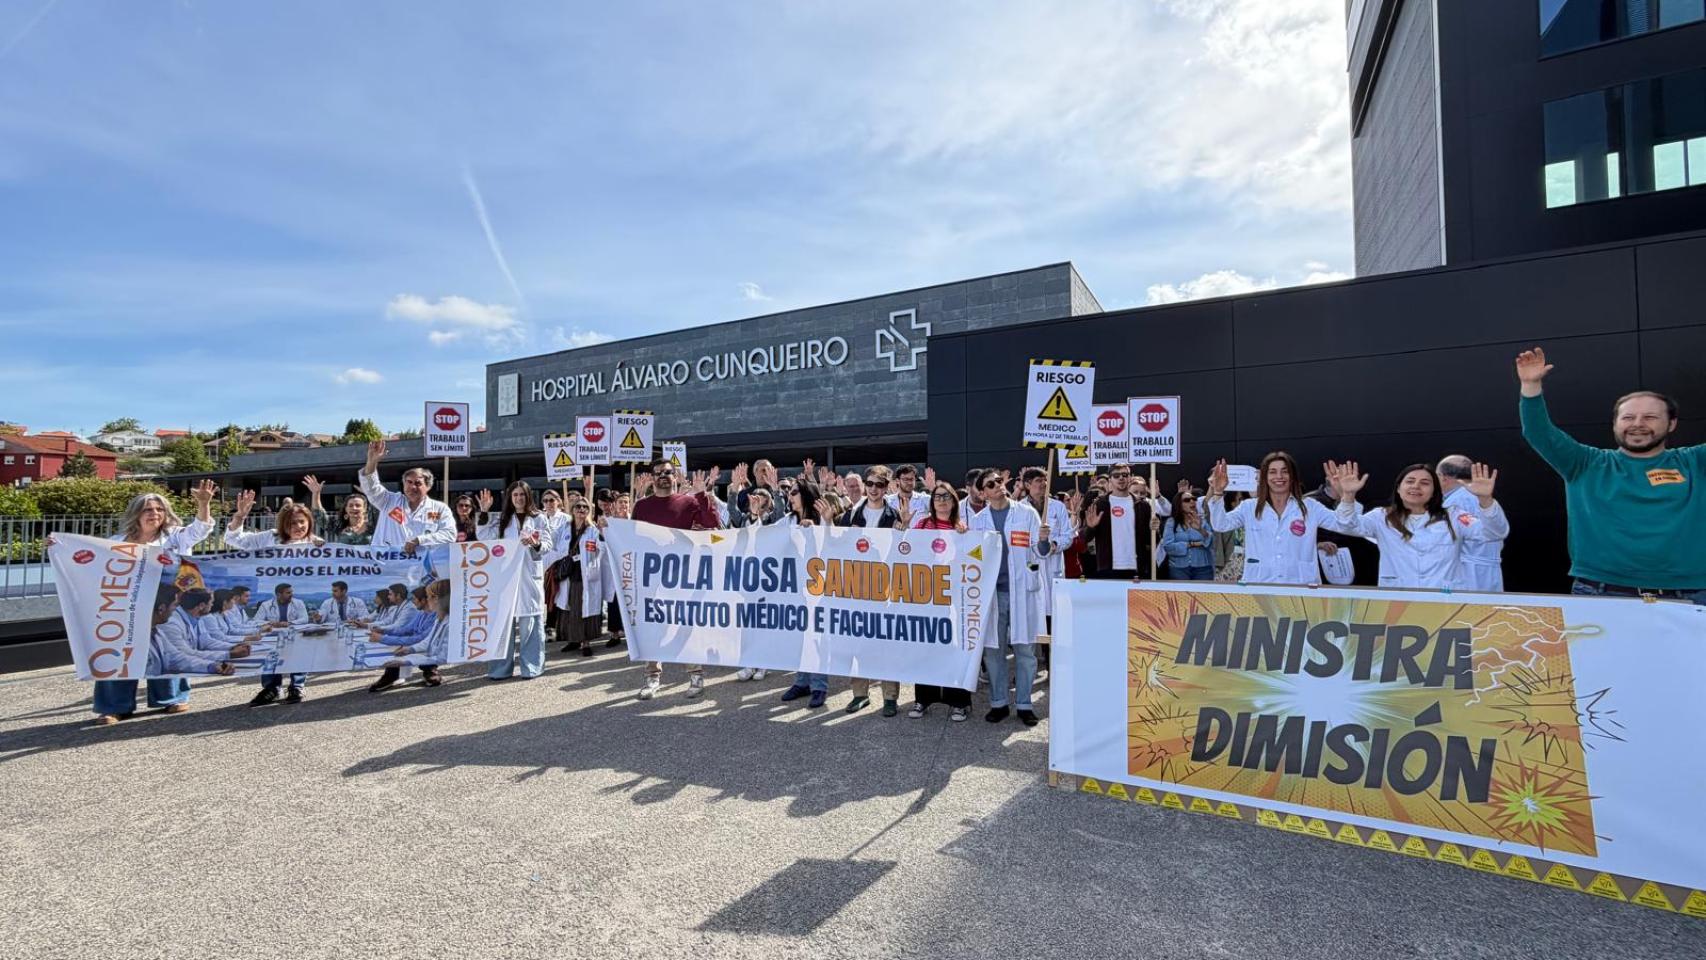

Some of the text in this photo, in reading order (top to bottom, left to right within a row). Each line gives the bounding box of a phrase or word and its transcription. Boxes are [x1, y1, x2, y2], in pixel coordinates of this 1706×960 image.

[531, 336, 850, 402] HOSPITAL ÁLVARO CUNQUEIRO
[1036, 372, 1086, 385] RIESGO
[435, 414, 460, 424] STOP
[617, 417, 649, 426] RIESGO
[1098, 417, 1123, 429] STOP
[1140, 411, 1168, 424] STOP
[583, 426, 604, 436] STOP
[429, 433, 466, 443] TRABALLO
[547, 440, 576, 448] RIESGO
[1132, 436, 1174, 446] TRABALLO
[430, 442, 464, 452] SEN LÍMITE
[1133, 446, 1173, 457] SEN LÍMITE
[1094, 451, 1107, 460] SEN
[255, 547, 332, 559] ESTAMOS
[335, 547, 354, 559] EN
[356, 550, 373, 560] LA
[255, 563, 382, 577] SOMOS EL MENÚ
[642, 552, 713, 591] POLA
[723, 556, 798, 593] NOSA
[806, 557, 952, 606] SANIDADE
[644, 597, 731, 628] ESTATUTO
[736, 596, 809, 632] MÉDICO
[814, 606, 825, 634] E
[829, 608, 952, 645] FACULTATIVO
[1174, 613, 1474, 690] MINISTRA
[1190, 701, 1498, 803] DIMISIÓN
